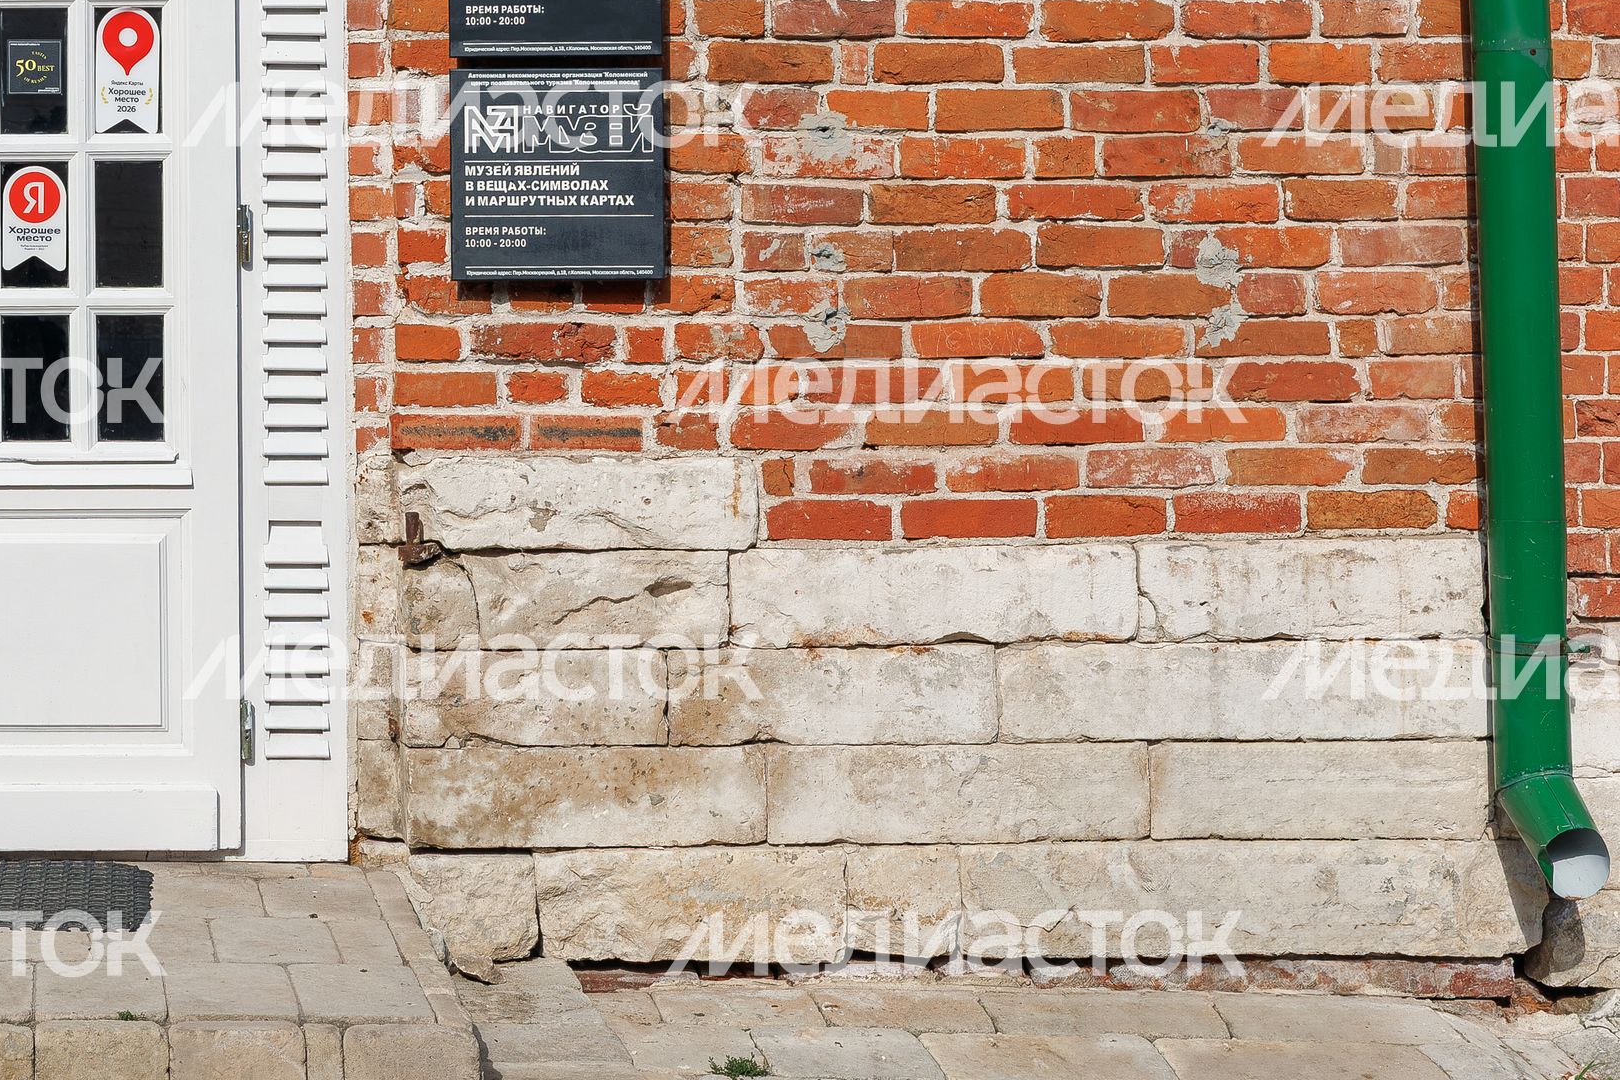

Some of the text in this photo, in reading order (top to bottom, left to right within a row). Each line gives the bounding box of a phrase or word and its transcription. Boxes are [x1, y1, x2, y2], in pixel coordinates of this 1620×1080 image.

[465, 5, 545, 14] ВРЕМЯ РАБОТЫ:
[465, 17, 491, 26] 10:00
[499, 16, 525, 25] 20:00
[15, 59, 36, 77] 50
[108, 88, 146, 97] Хорошее
[523, 104, 620, 114] НАВИГАТОР
[465, 163, 579, 176] МУЗЕЙ ЯВЛЕНИЙ
[466, 180, 608, 192] В ВЕЩАХ-СИМВОЛАХ
[23, 182, 44, 213] Я
[465, 195, 634, 206] И МАРШРУТНЫХ КАРТАХ
[9, 226, 61, 235] Хорошее
[465, 227, 547, 236] ВРЕМЯ РАБОТЫ:
[16, 234, 52, 242] место
[465, 238, 491, 248] 10:00
[500, 238, 526, 247] 20:00
